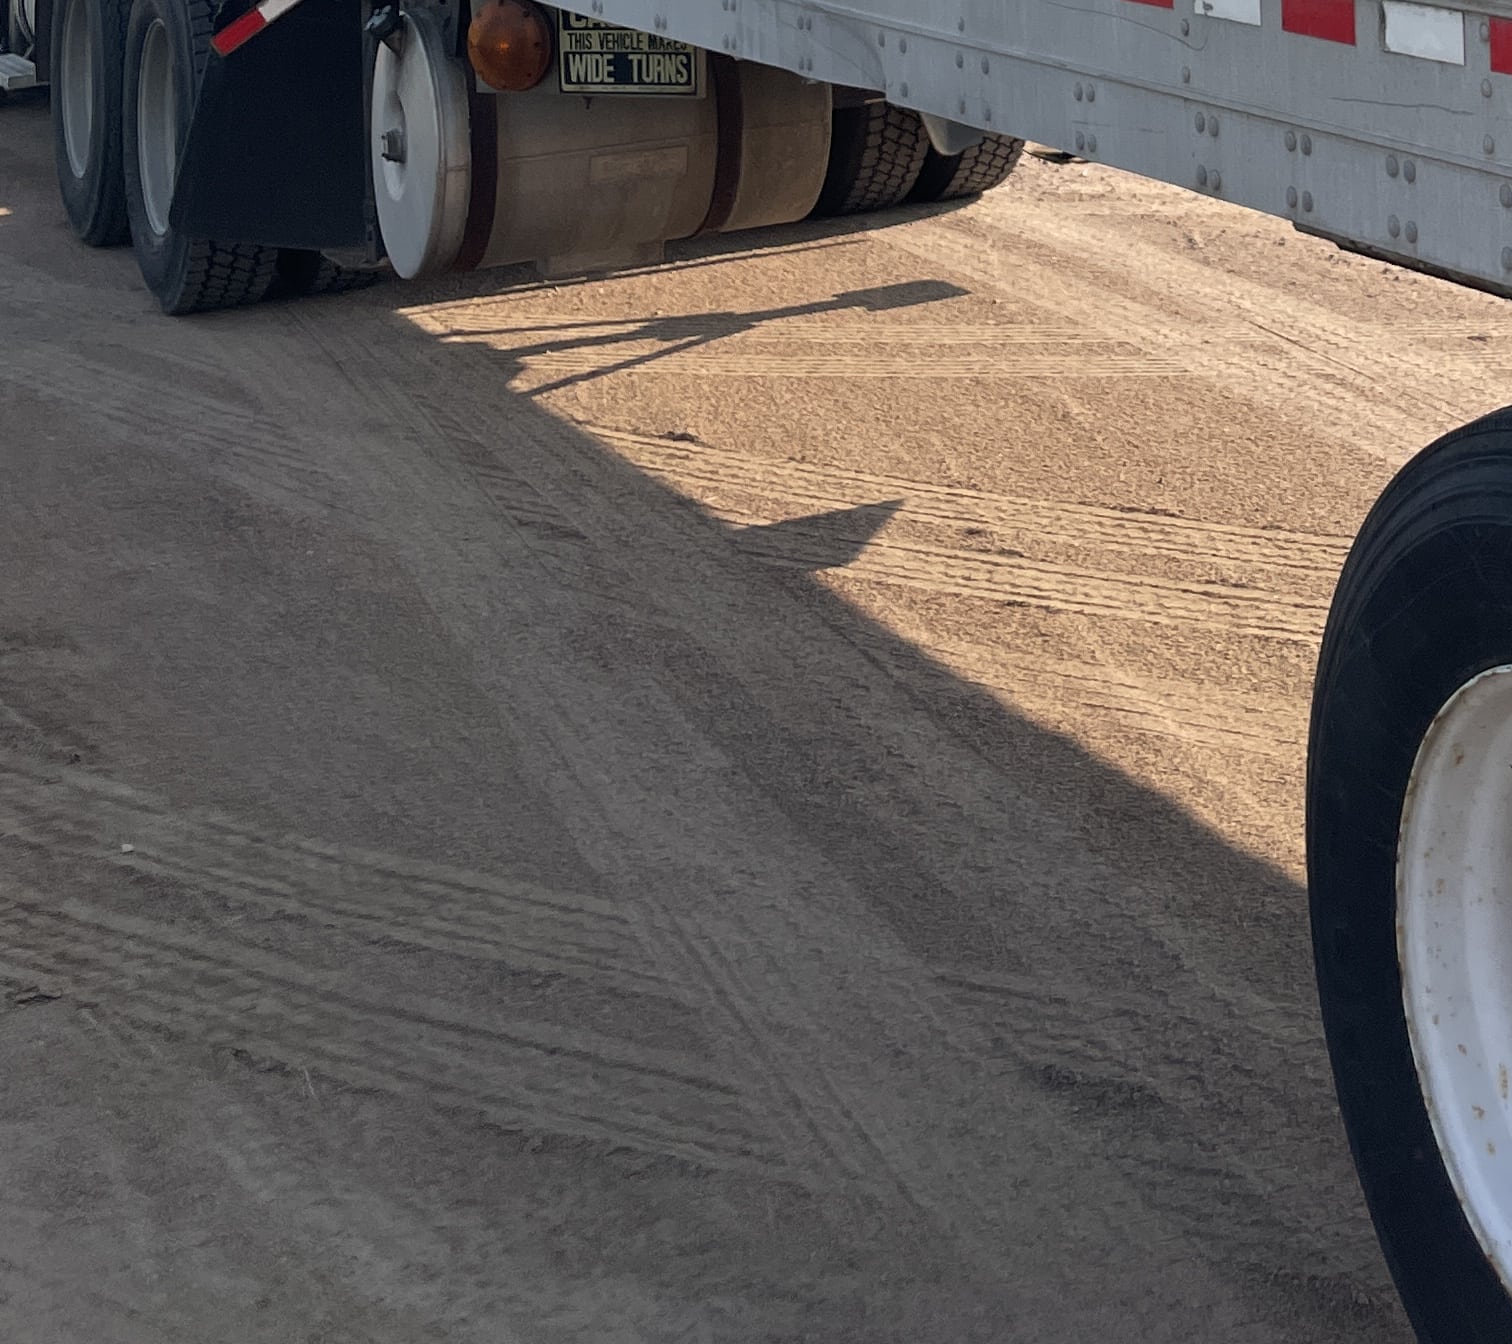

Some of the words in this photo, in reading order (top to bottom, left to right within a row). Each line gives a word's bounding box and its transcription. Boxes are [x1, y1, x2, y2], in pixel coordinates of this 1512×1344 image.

[568, 33, 592, 50] THIS
[598, 33, 643, 50] VEHICLE
[569, 54, 615, 83] WIDE
[628, 54, 688, 83] TURNS
